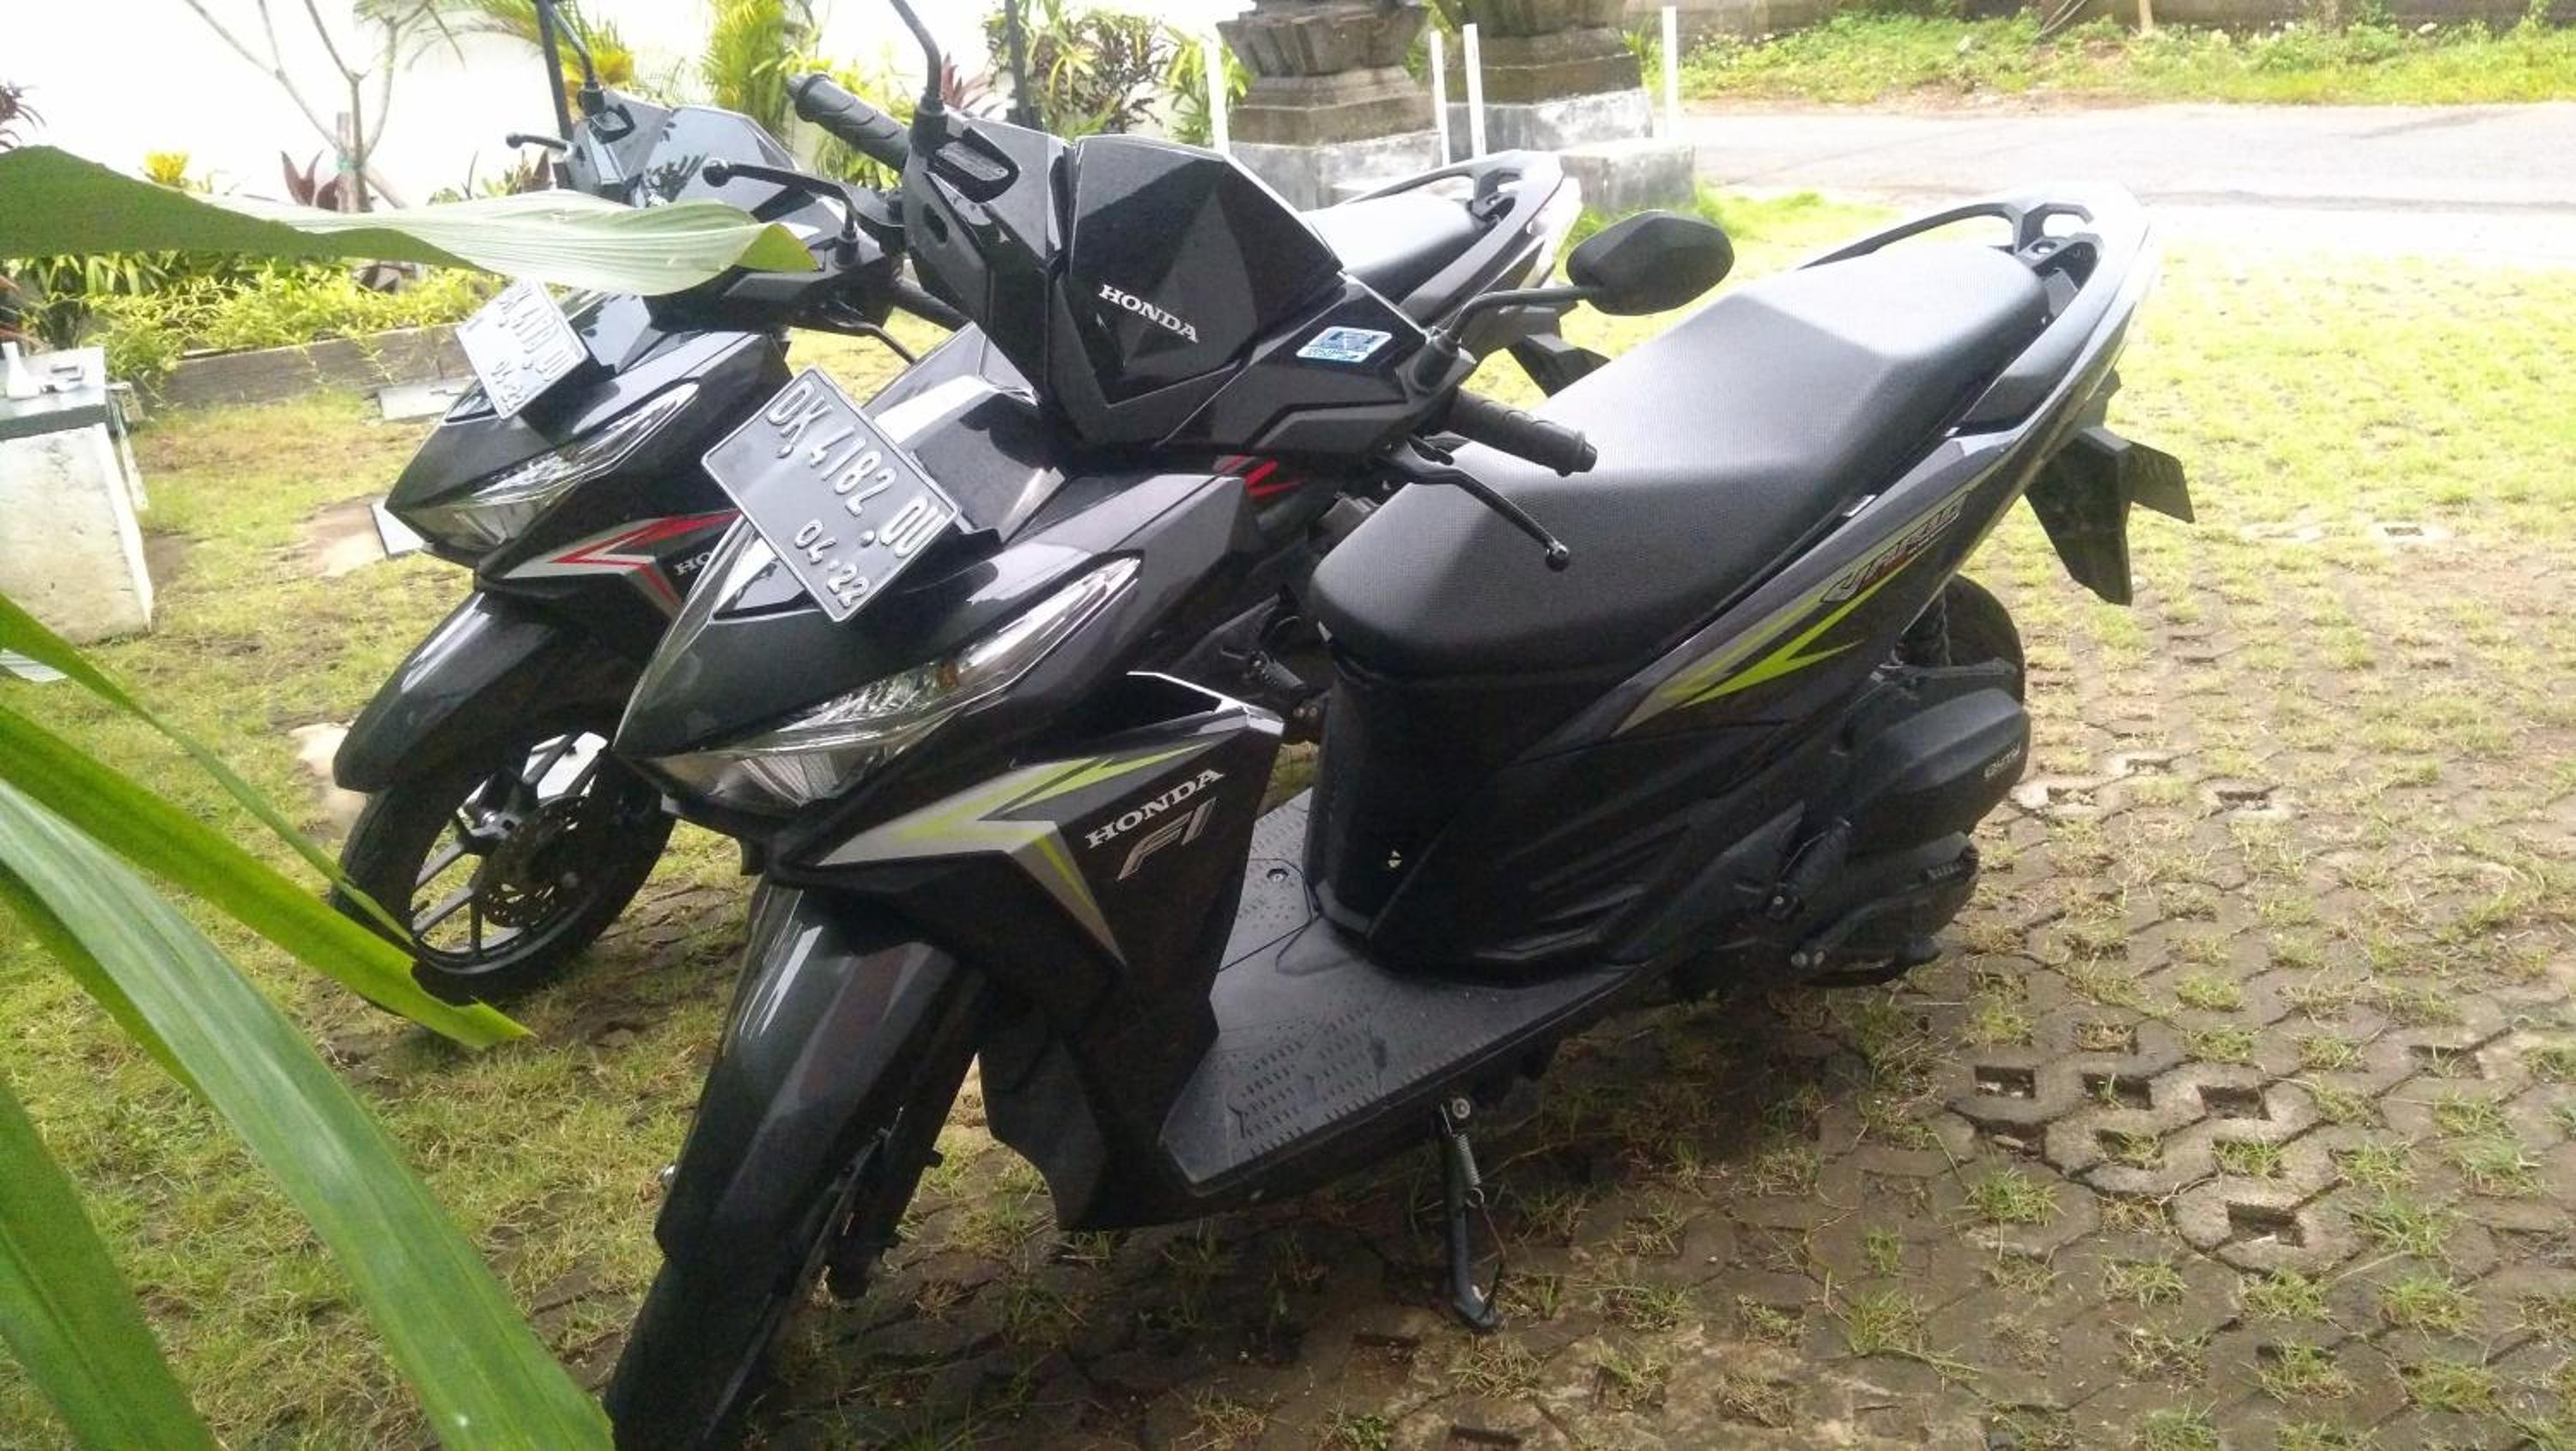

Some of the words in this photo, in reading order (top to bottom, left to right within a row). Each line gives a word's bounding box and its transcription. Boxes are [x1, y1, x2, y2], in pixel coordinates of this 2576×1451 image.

[1098, 284, 1200, 343] HONDA
[767, 380, 835, 445] DK
[810, 426, 898, 517] 4182
[1085, 768, 1224, 849] HONDA
